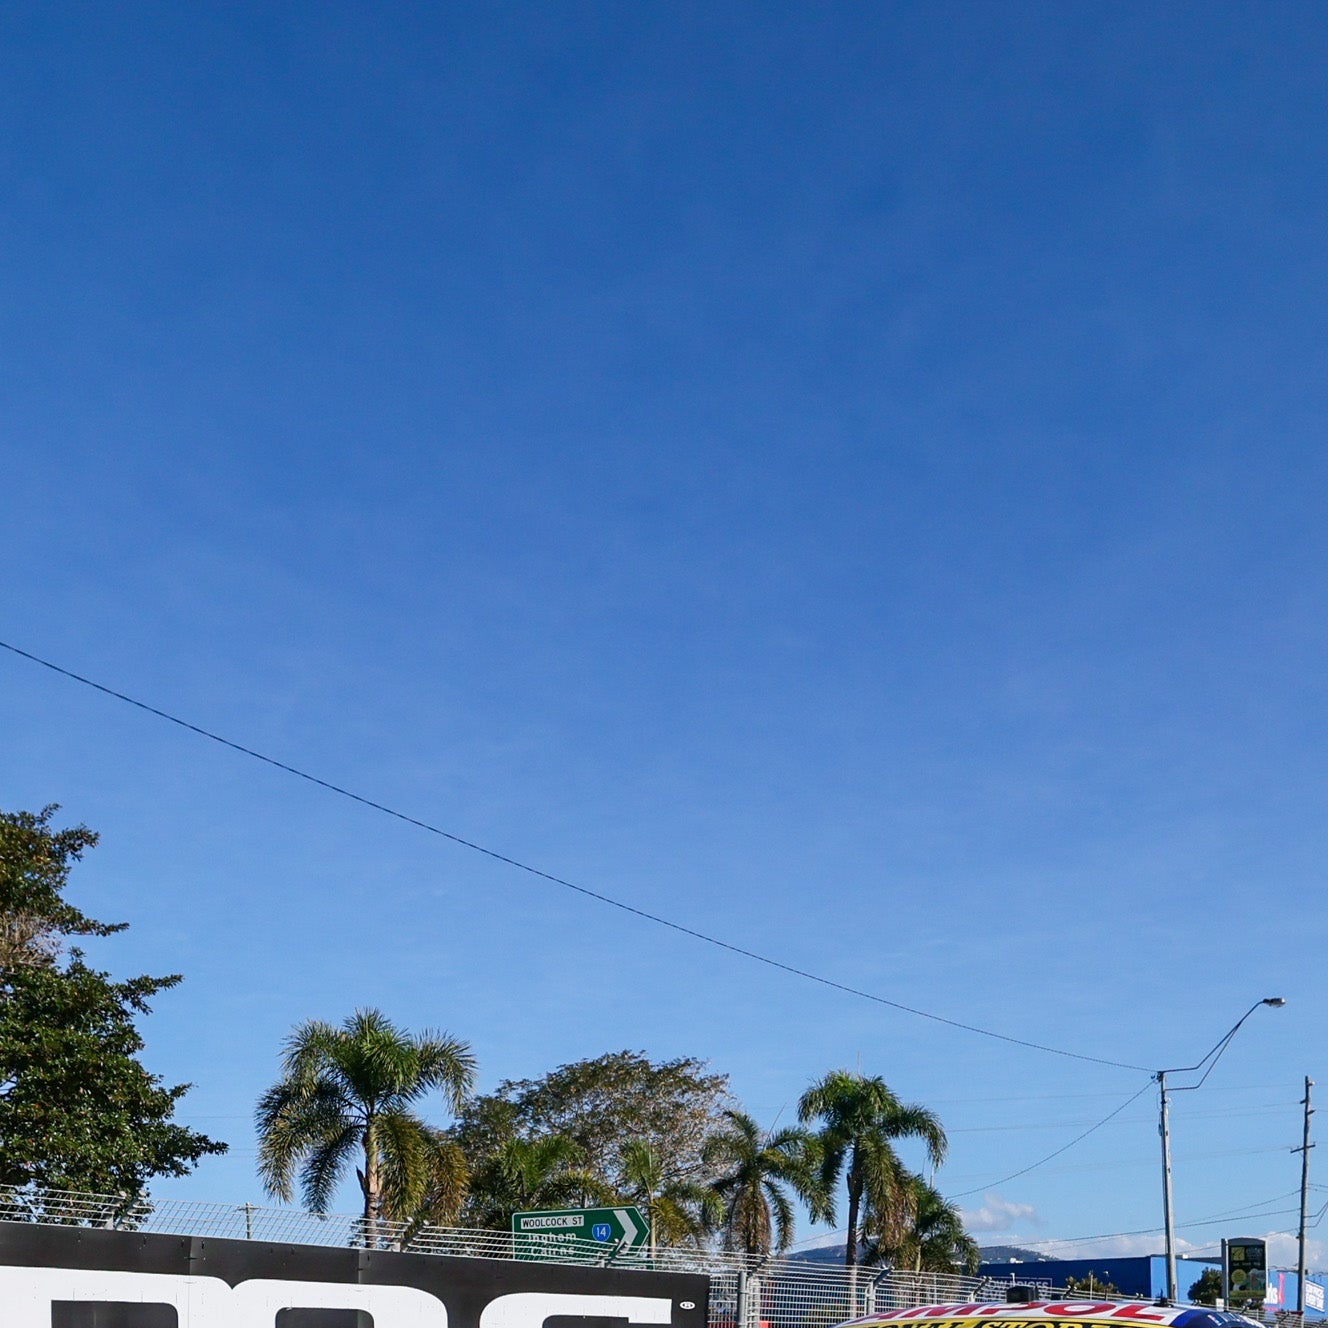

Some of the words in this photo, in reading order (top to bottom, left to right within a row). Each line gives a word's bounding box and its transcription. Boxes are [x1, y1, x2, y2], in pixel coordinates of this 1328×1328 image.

[522, 1217, 568, 1228] WOOLCOCK
[572, 1216, 583, 1225] ST
[596, 1226, 607, 1238] 14
